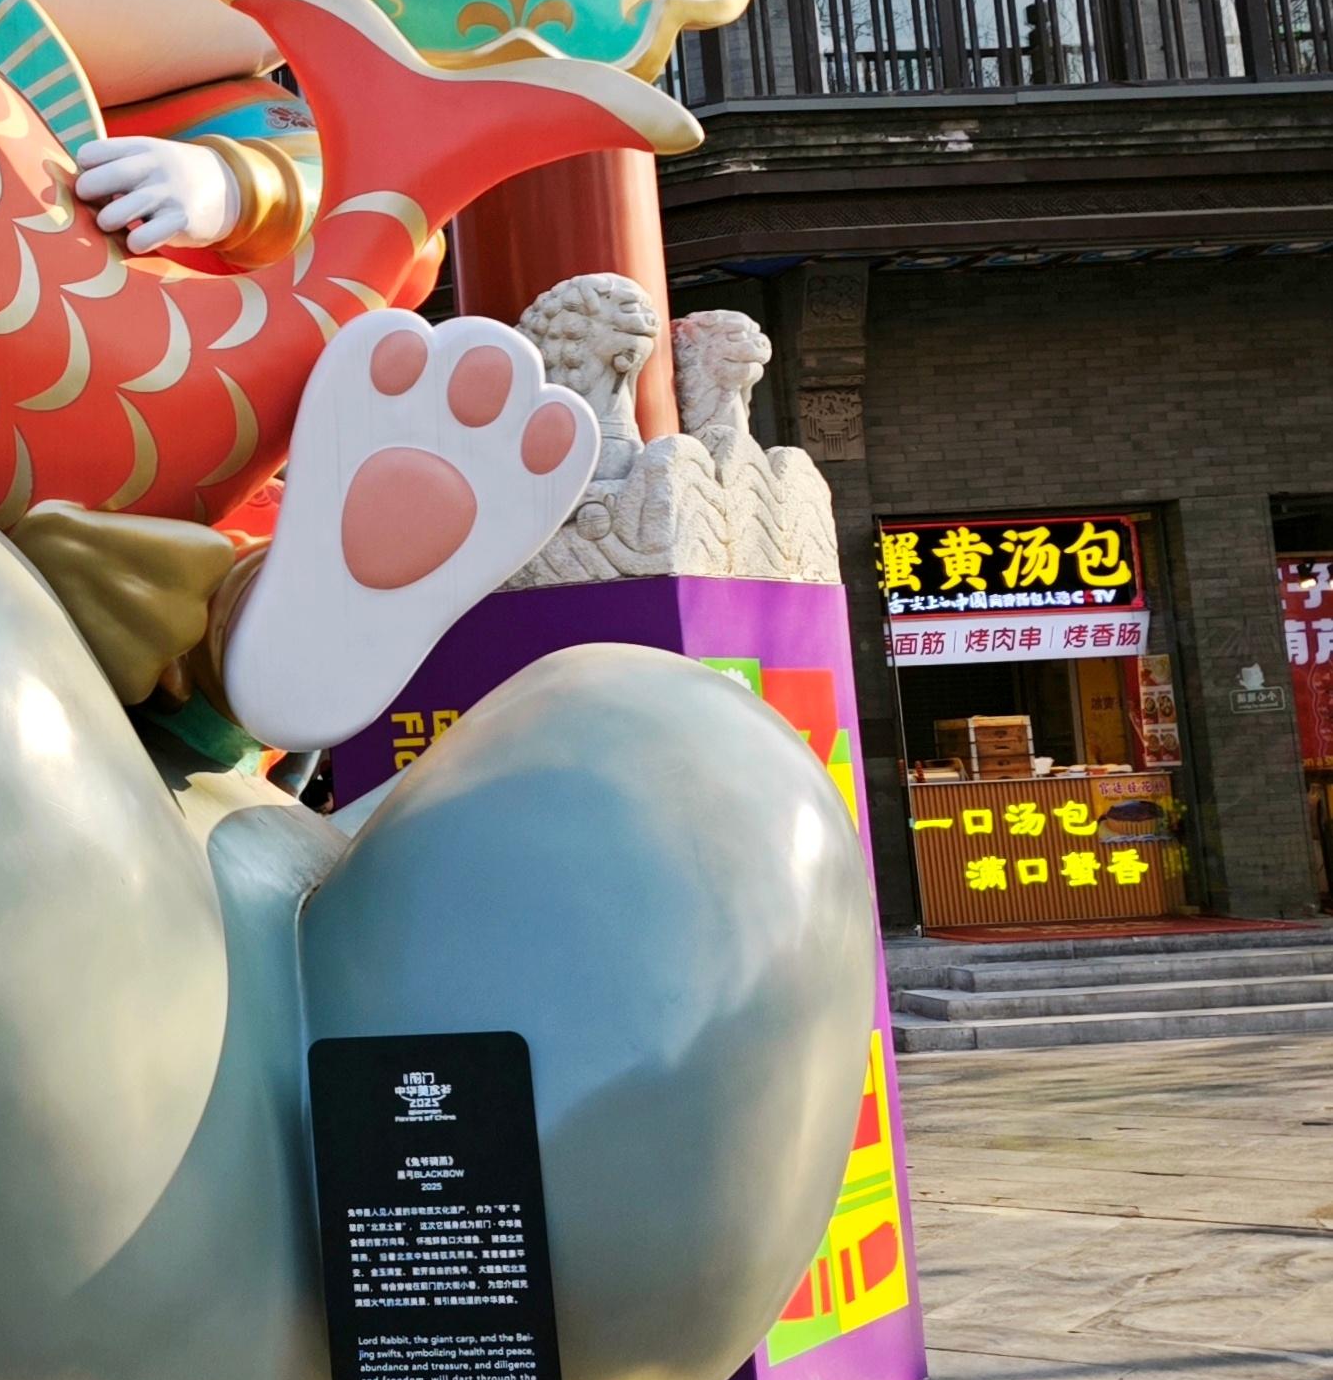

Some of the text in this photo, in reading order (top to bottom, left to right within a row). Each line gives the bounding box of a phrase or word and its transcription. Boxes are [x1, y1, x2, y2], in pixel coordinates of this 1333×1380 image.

[874, 522, 1132, 592] 蟹黄汤包
[884, 622, 1141, 657] 面筋 烤肉串 烤香肠
[913, 800, 1098, 836] 一口汤包
[965, 849, 1149, 891] 满口蟹香
[420, 1182, 443, 1191] 2025
[358, 1333, 534, 1347] Lord Rabbit, the giant carp, and the Bei-
[359, 1347, 535, 1360] jing swifts, symbolizing health and peace,
[360, 1360, 536, 1372] abundance and treasure, and diligence
